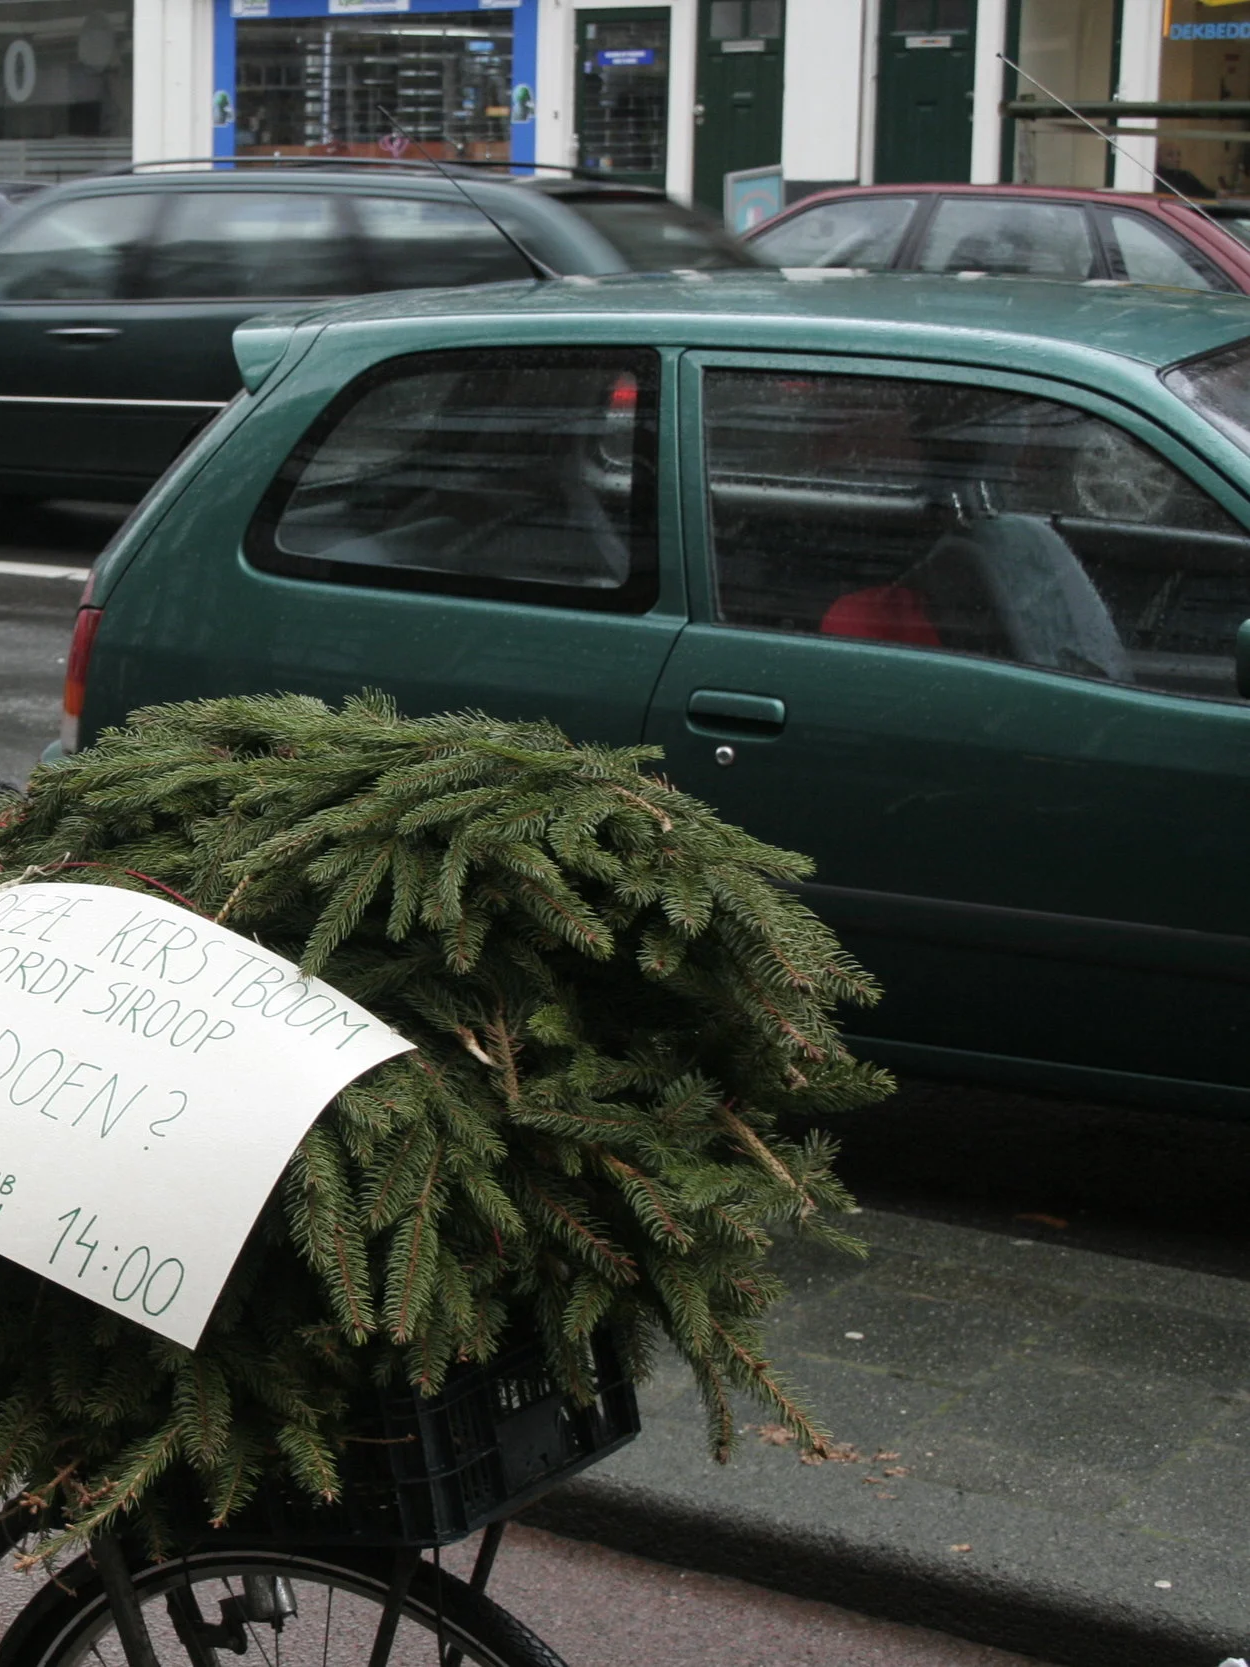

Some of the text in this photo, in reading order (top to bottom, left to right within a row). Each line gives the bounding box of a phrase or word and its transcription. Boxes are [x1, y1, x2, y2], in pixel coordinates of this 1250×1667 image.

[82, 982, 236, 1054] SIROOP
[96, 910, 371, 1051] KERSTBOOM
[48, 1207, 185, 1317] 14:00
